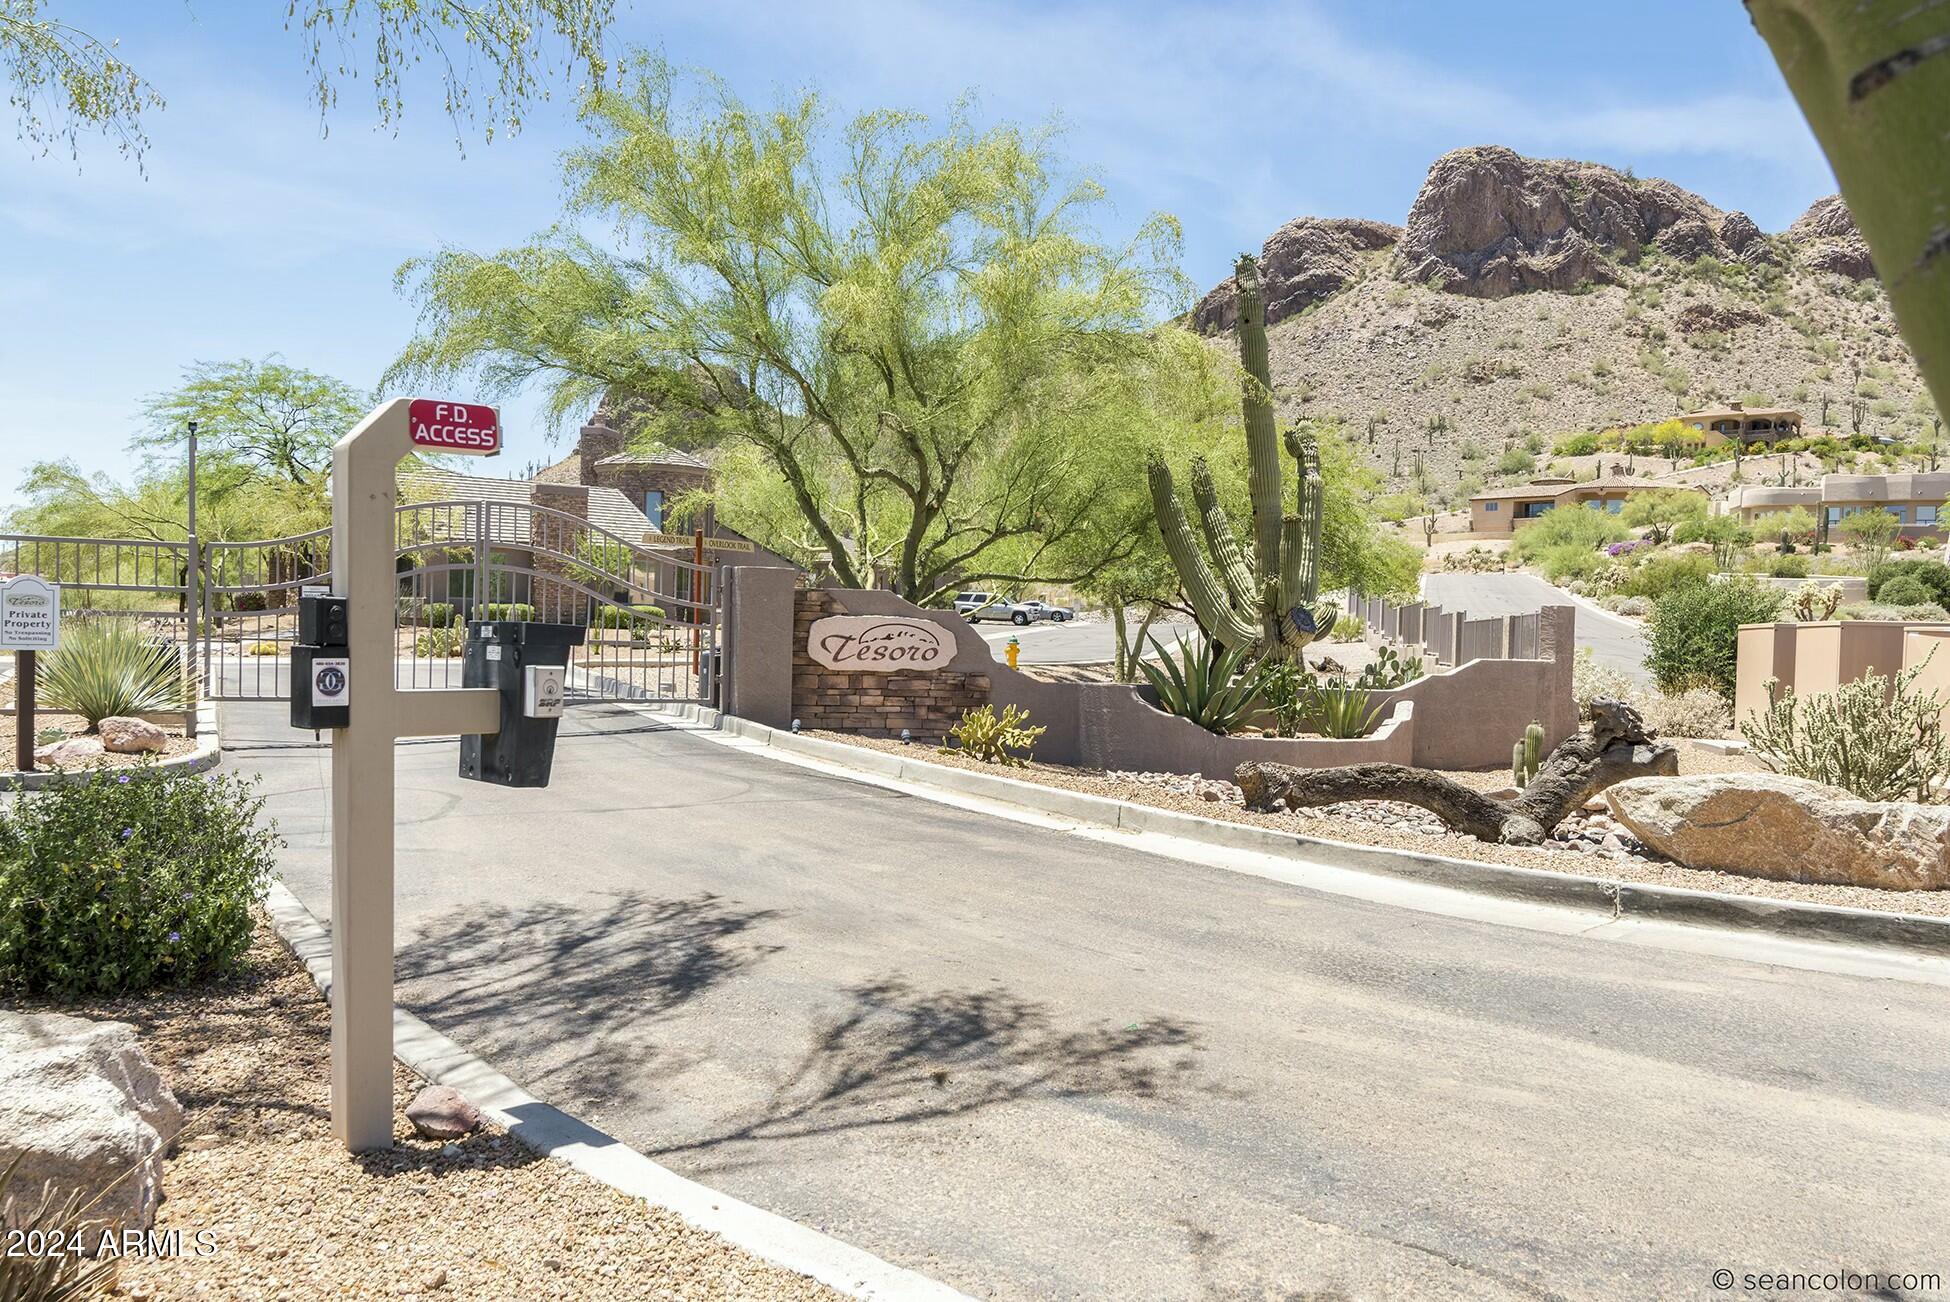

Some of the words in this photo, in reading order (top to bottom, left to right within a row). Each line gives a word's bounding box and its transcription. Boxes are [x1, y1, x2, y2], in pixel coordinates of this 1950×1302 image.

[435, 404, 473, 424] F.D.
[415, 423, 494, 447] ACCESS
[653, 535, 676, 544] LEGEND
[676, 536, 690, 545] TRAIL
[708, 539, 737, 549] OVERLOOK
[737, 542, 751, 550] TRAIL
[9, 610, 48, 618] Private
[4, 620, 51, 629] Property
[820, 634, 939, 663] Tesoro
